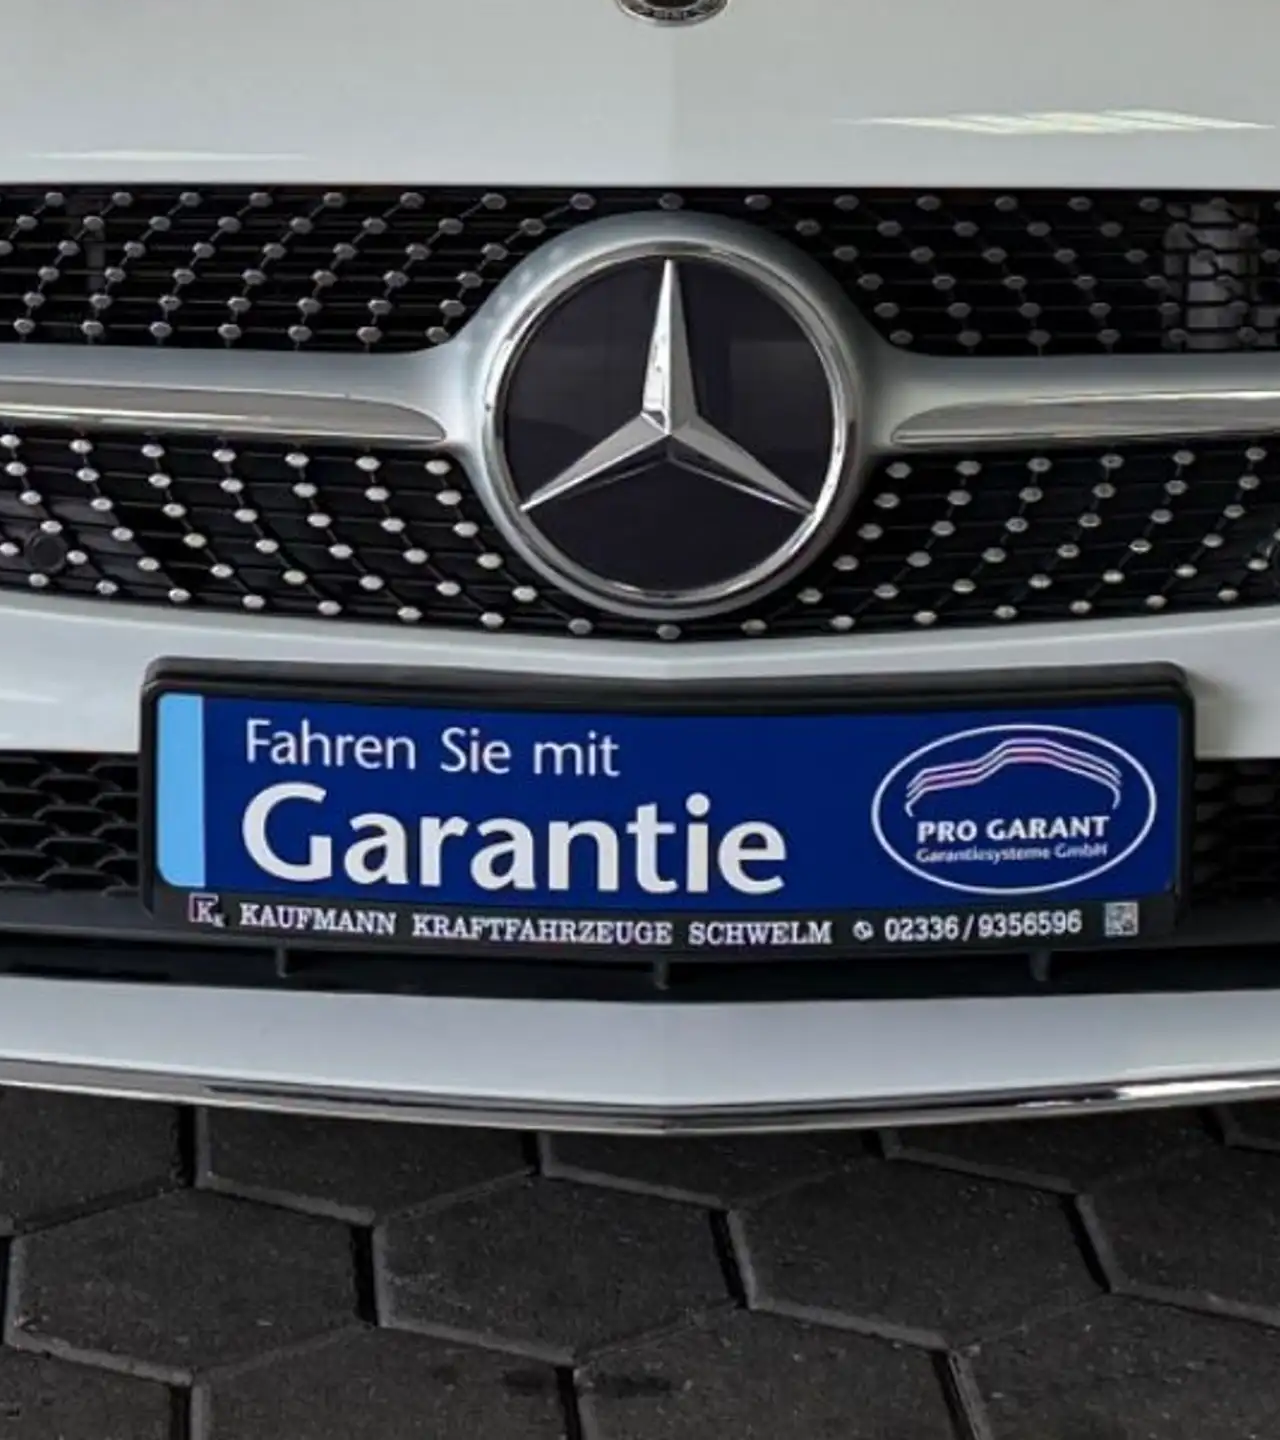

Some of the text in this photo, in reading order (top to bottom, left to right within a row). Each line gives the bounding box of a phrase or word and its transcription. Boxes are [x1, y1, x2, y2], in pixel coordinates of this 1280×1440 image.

[244, 717, 621, 777] Fahren Sie mit
[240, 780, 788, 895] Garantie
[916, 815, 1111, 844] PRO GARANT
[1053, 842, 1108, 860] GmbH
[239, 902, 397, 936] KAUFMANN
[412, 913, 673, 946] KRAFTFAHRZEUGE
[688, 920, 834, 946] SCHWELM
